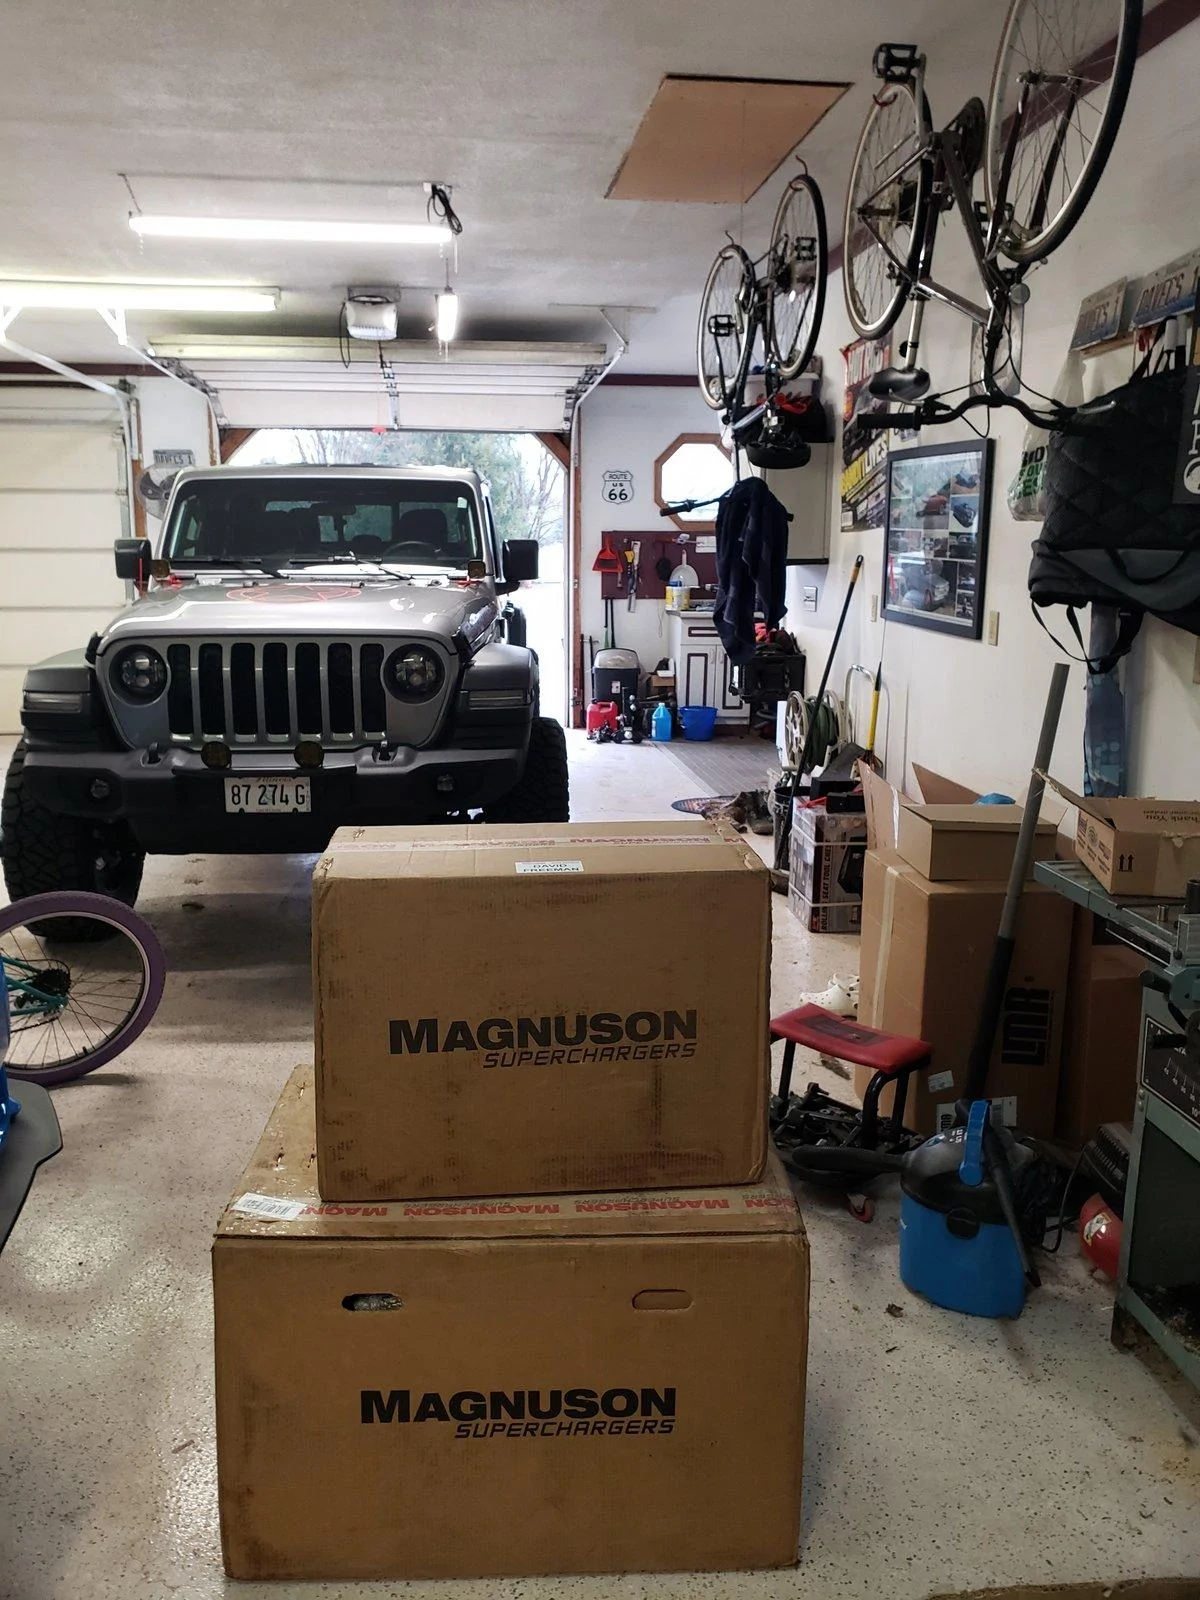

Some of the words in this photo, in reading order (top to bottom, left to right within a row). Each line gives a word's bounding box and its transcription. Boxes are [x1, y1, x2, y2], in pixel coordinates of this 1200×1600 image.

[608, 488, 628, 501] 66
[231, 784, 251, 806] 87
[258, 784, 290, 806] 274
[295, 784, 306, 806] G
[823, 863, 831, 881] TOOL
[389, 1009, 698, 1055] MAGNUSON
[482, 1042, 698, 1069] SUPERCHARGERS
[403, 1204, 560, 1216] MAGNUSON
[575, 1199, 730, 1213] MAGNUSON
[360, 1387, 677, 1424] MAGNUSON
[454, 1418, 676, 1439] SUPERCHARGERS
